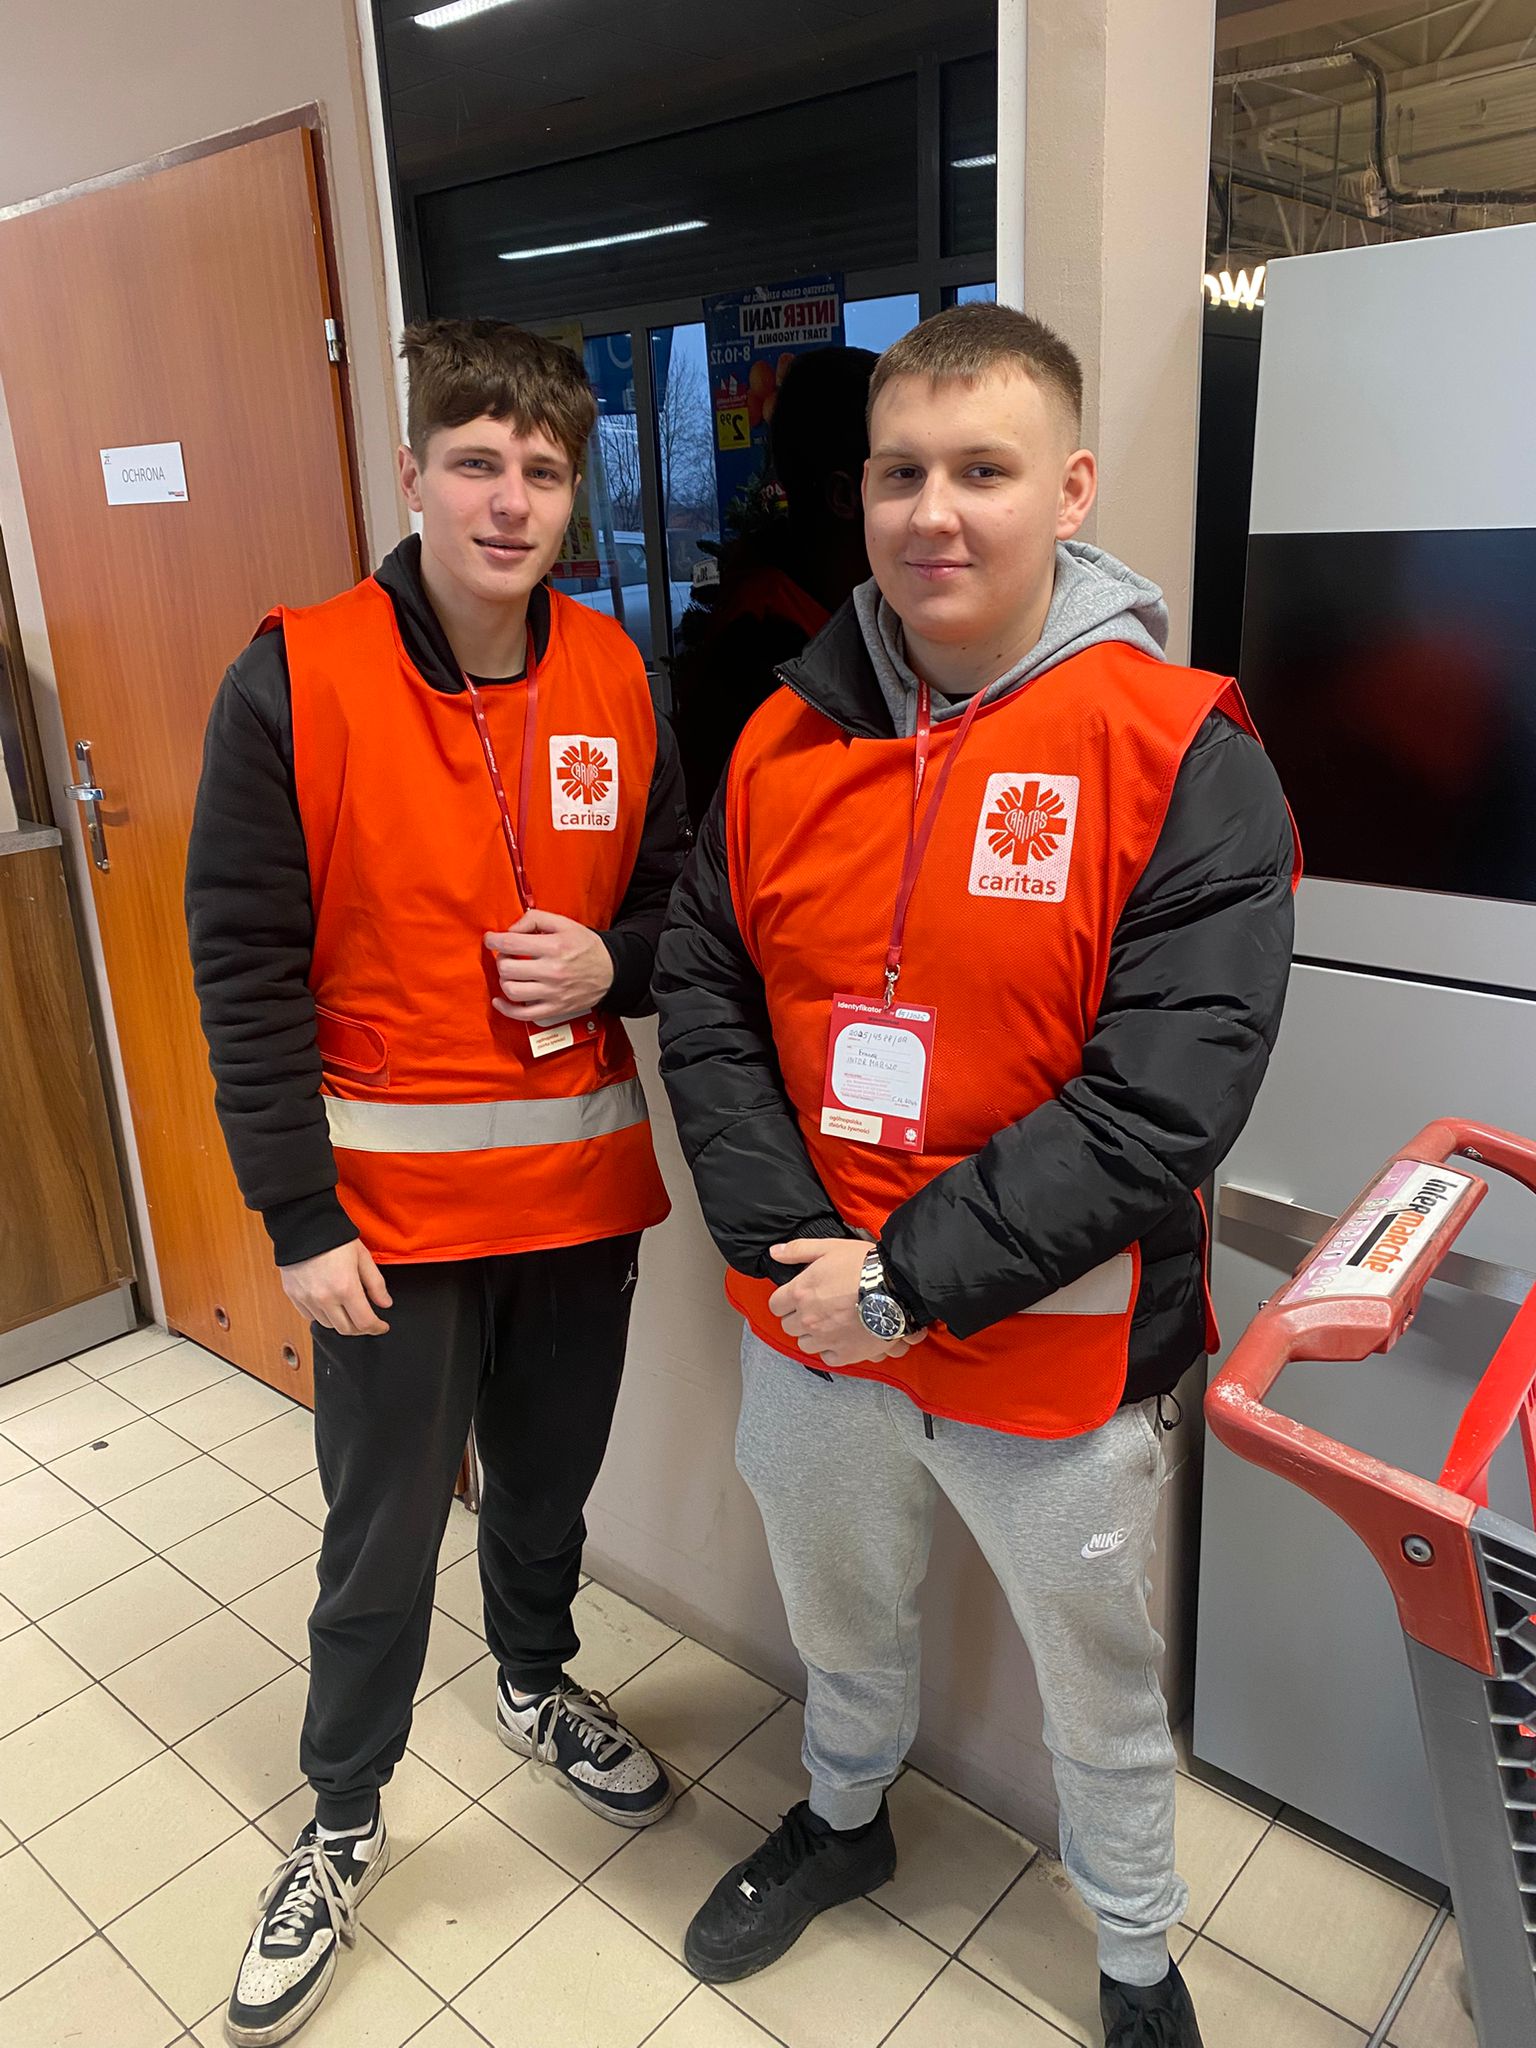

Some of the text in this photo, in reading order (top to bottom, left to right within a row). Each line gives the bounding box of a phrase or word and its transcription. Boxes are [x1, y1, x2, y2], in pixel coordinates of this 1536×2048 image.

[122, 467, 165, 483] OCHRONA
[560, 809, 611, 826] caritas
[1004, 808, 1049, 844] CARITAS
[978, 871, 1057, 896] caritas
[837, 1001, 883, 1014] Identyfikator
[1089, 1527, 1125, 1549] NIKE
